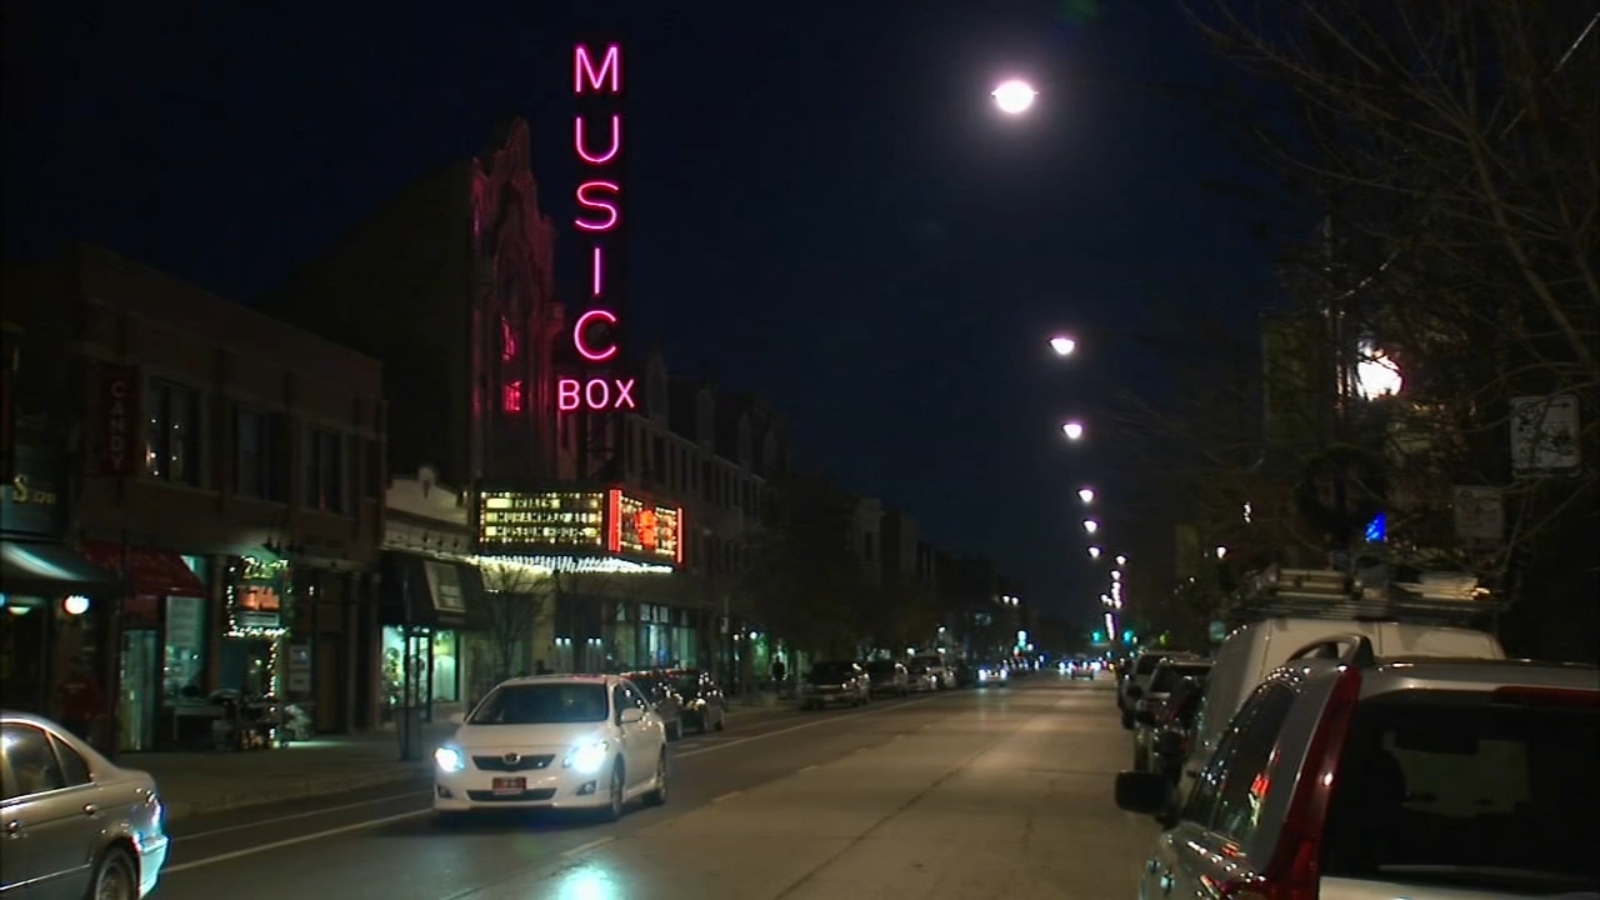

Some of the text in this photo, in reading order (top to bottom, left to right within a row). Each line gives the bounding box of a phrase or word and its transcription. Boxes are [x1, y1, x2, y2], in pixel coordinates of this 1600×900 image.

[573, 43, 620, 361] MUSIC
[109, 380, 126, 471] CANDY
[557, 378, 636, 411] BOX
